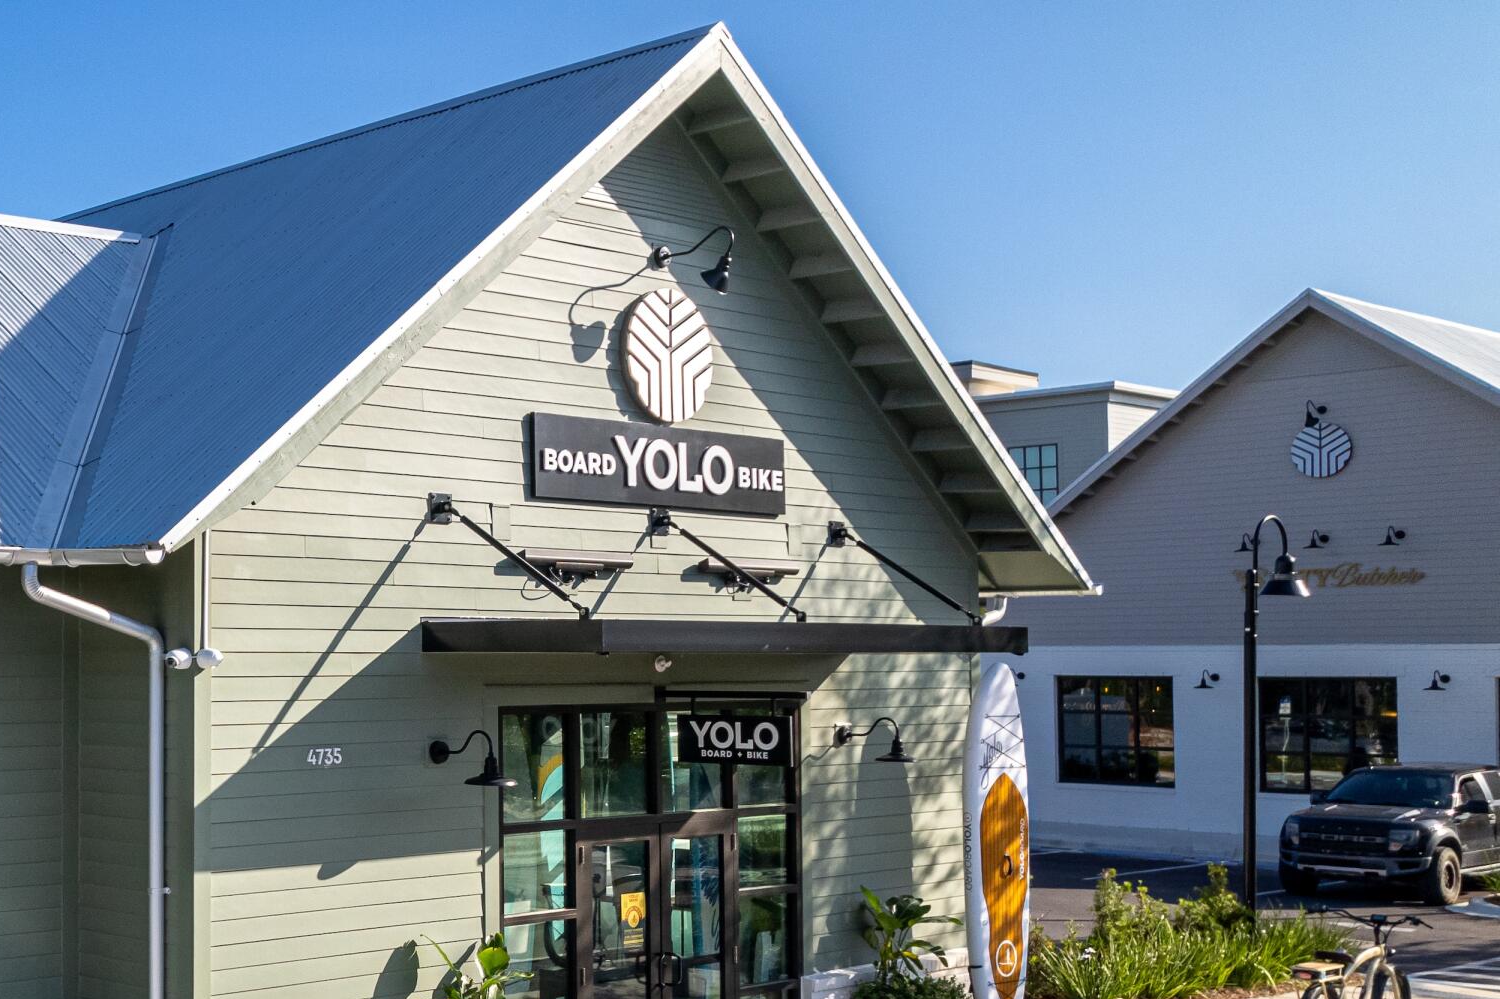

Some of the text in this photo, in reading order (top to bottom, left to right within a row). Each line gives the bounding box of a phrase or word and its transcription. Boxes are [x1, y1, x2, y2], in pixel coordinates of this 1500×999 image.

[543, 435, 784, 496] BOARD YOLO BIKE
[689, 720, 779, 750] YOLO
[307, 747, 342, 765] 4735
[701, 749, 733, 758] BOARD
[746, 751, 769, 760] BIKE
